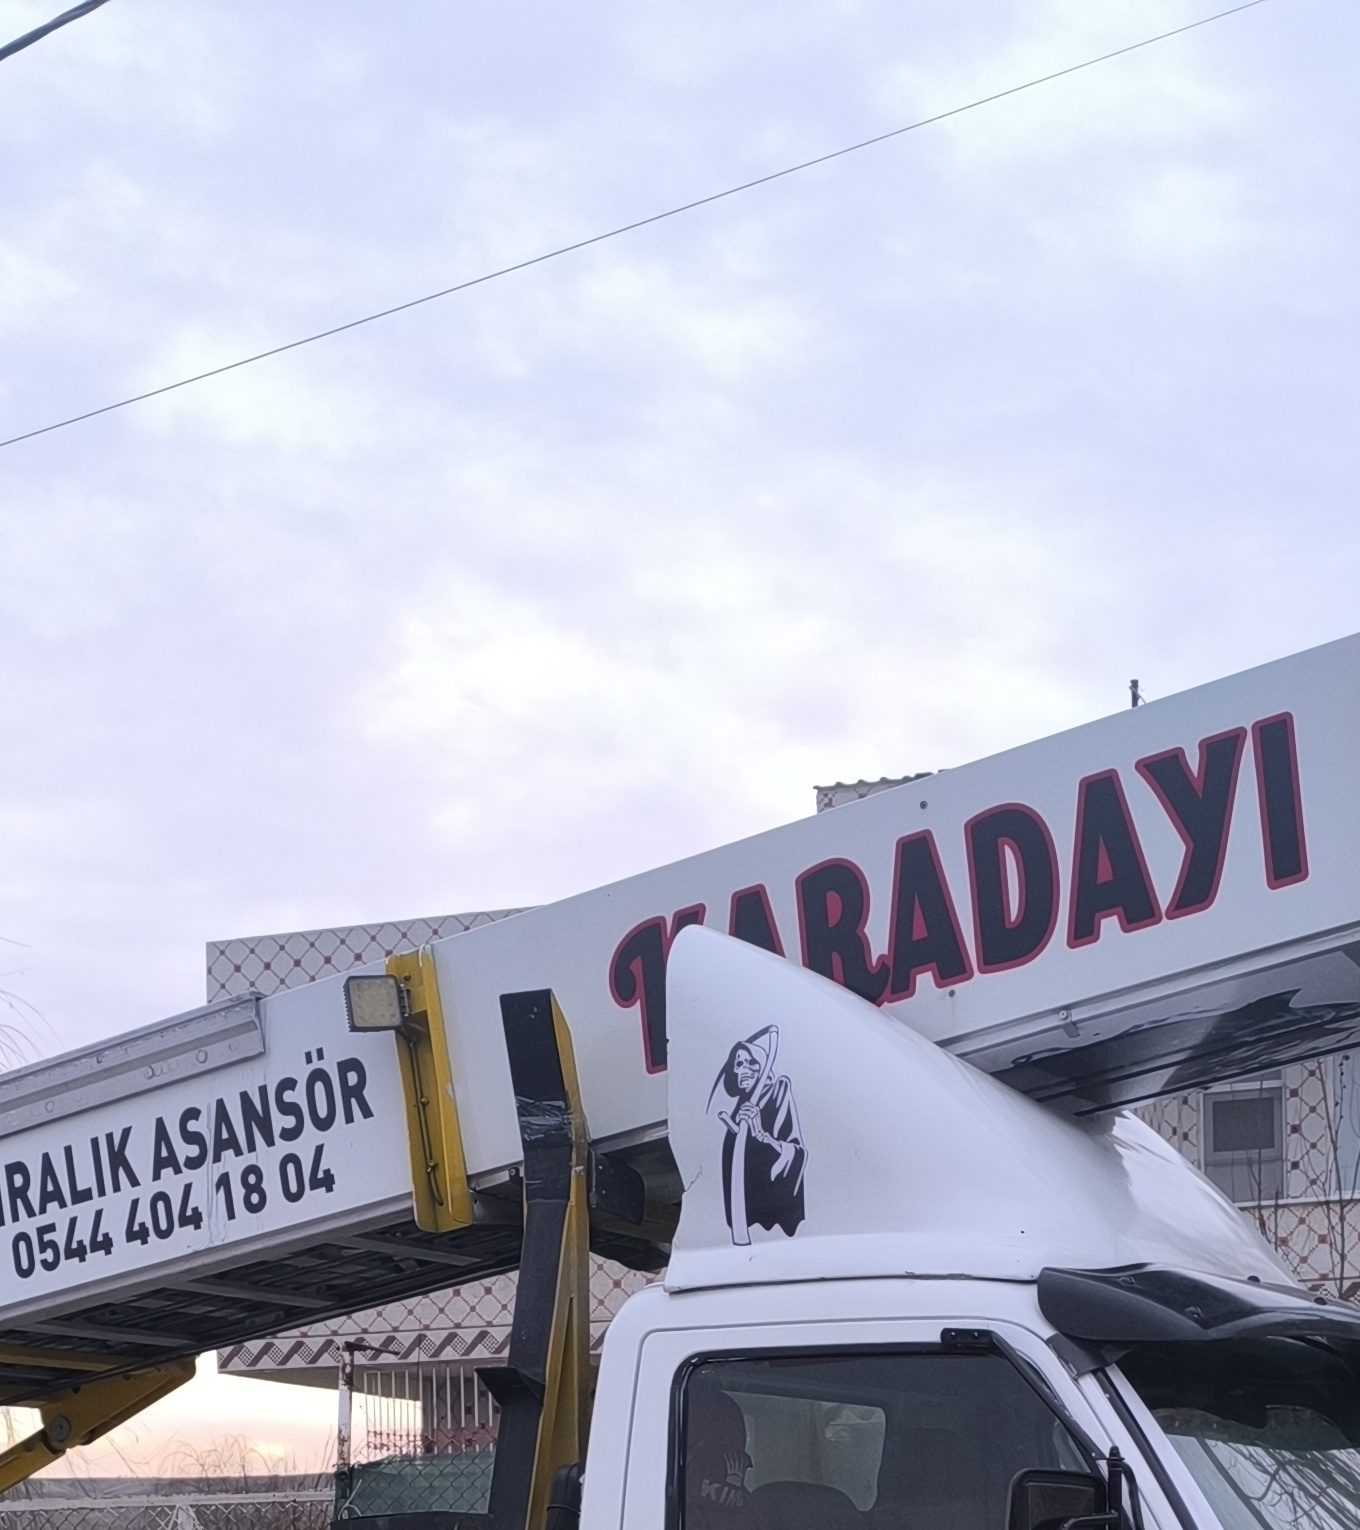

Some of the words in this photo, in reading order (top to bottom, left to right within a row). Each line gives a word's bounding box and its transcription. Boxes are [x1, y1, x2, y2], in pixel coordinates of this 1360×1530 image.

[150, 1047, 375, 1181] ASANSÖR
[11, 1209, 113, 1278] 0544
[125, 1182, 203, 1246] 404
[214, 1164, 267, 1222] 18
[280, 1143, 336, 1200] 04
